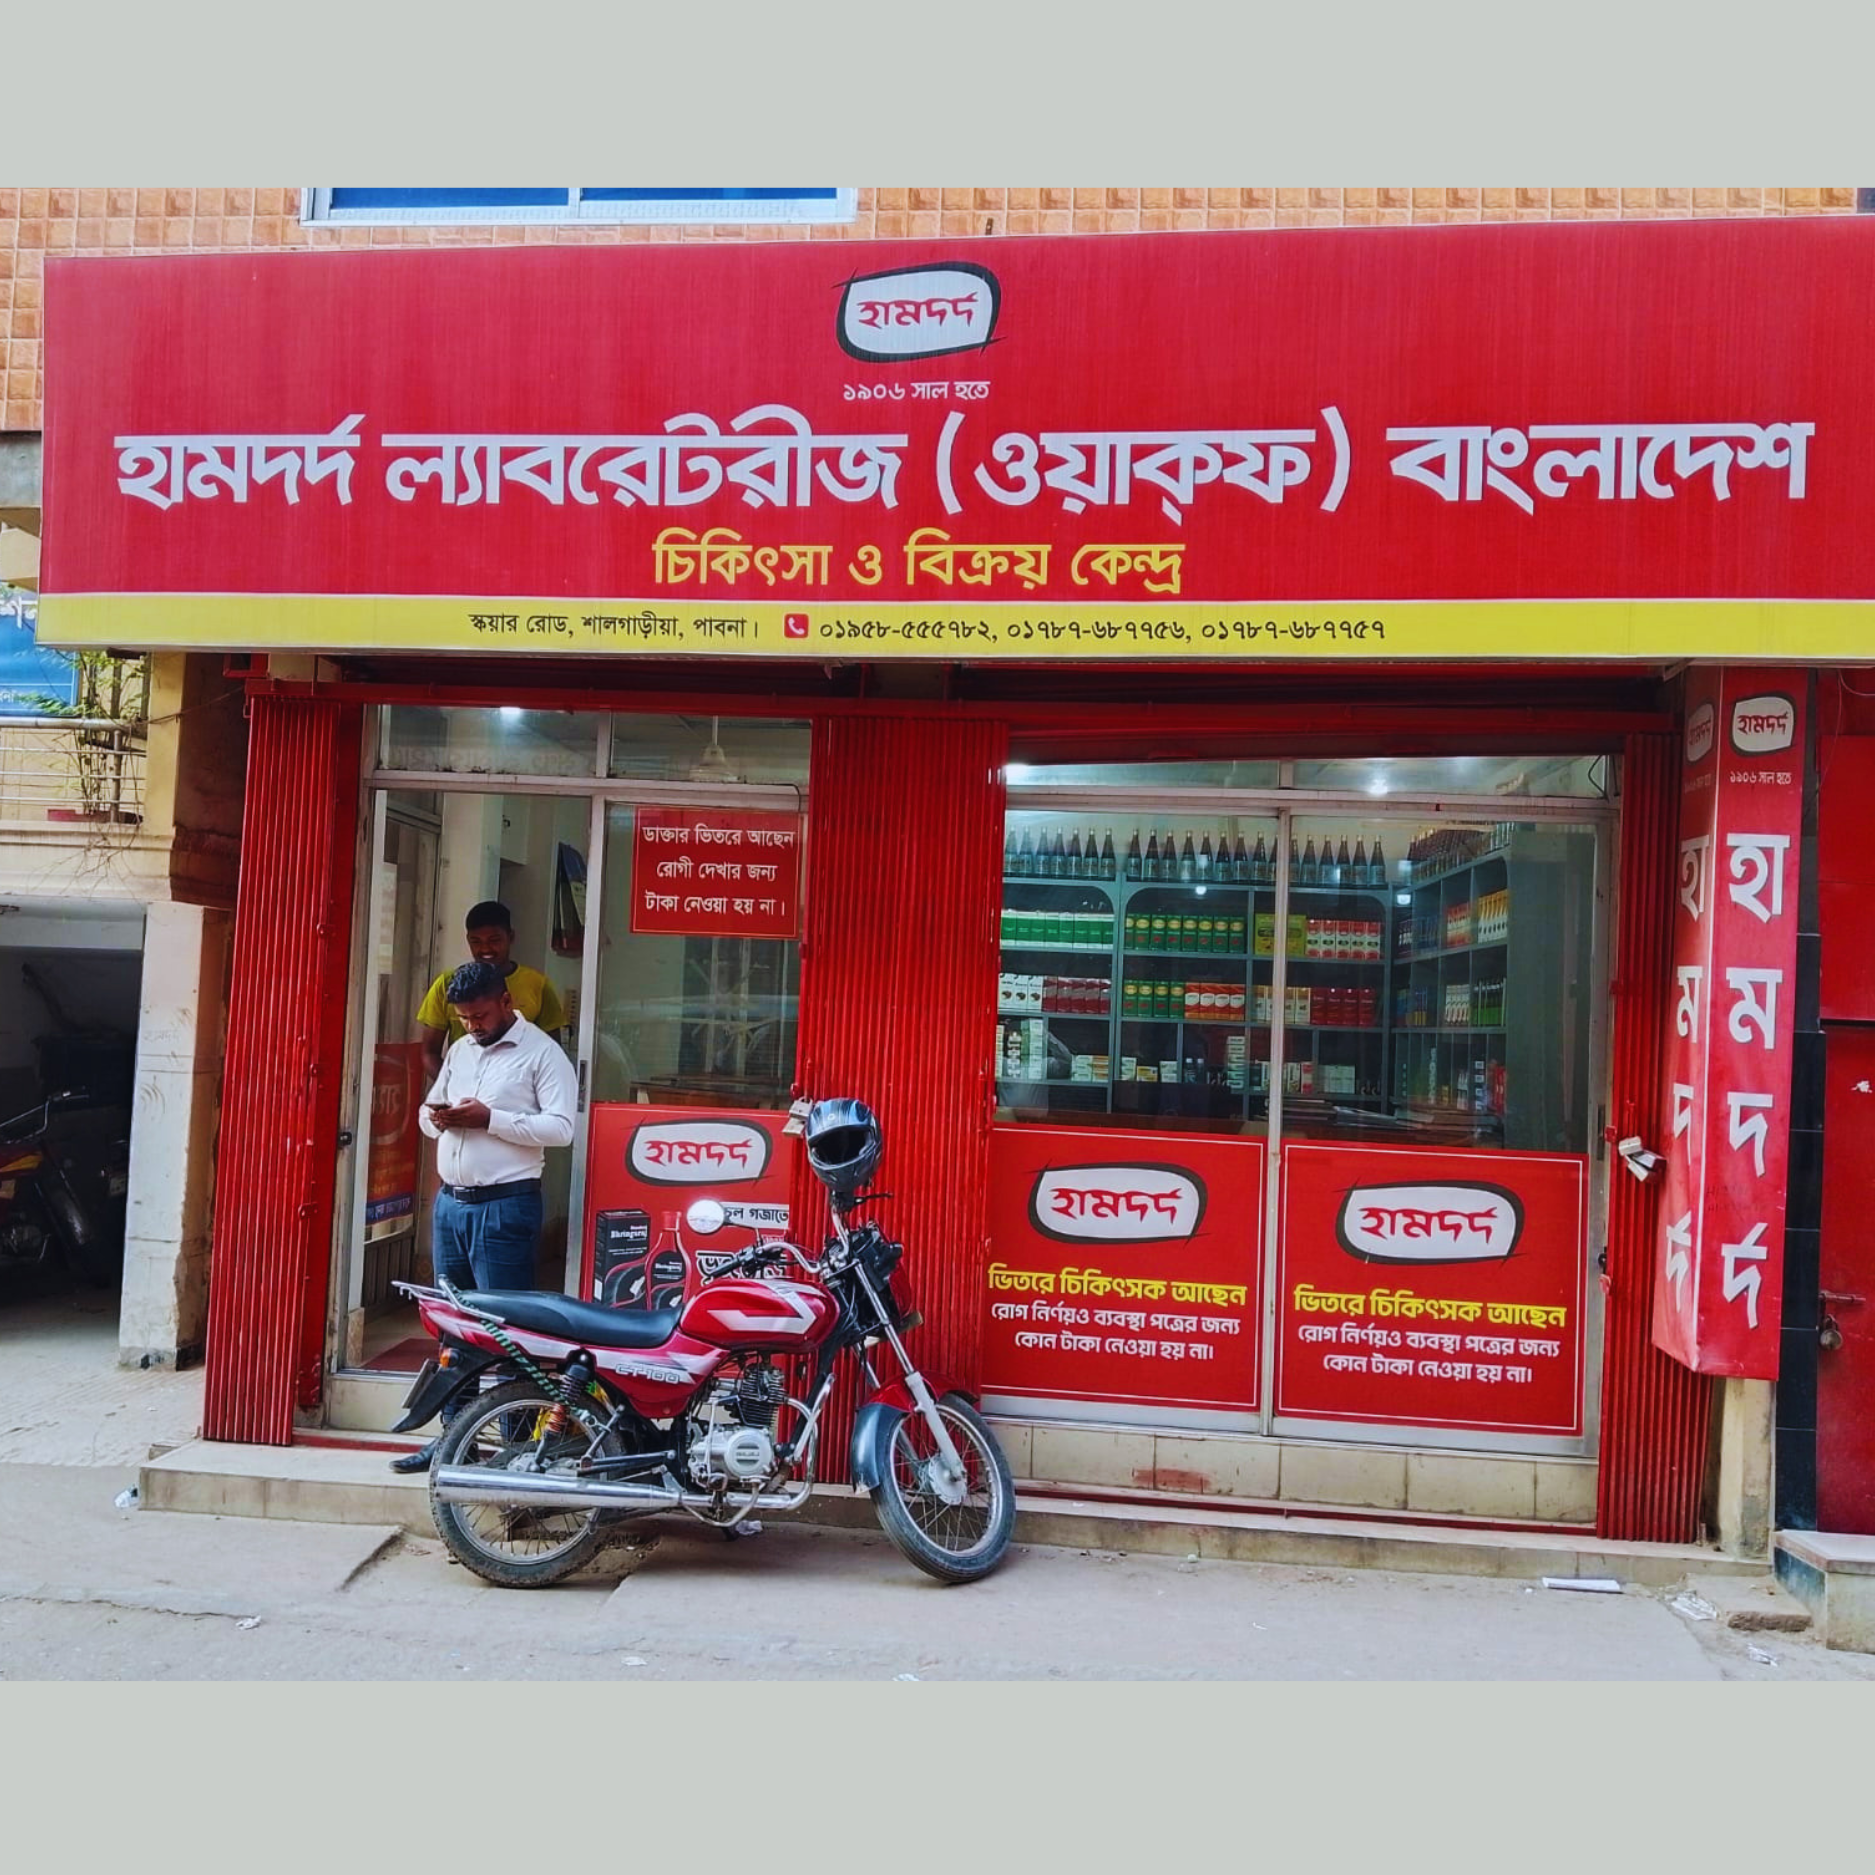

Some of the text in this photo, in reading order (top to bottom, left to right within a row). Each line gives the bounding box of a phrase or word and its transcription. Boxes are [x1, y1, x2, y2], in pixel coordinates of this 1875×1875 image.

[858, 292, 977, 328] হামদর্দ
[843, 381, 990, 400] ১৯০৬ সাল হতে
[114, 414, 365, 510] হামদর্দ
[381, 404, 908, 509] ল্যাবরেটরীজ
[1386, 423, 1815, 515] বাংলাদেশ
[652, 527, 1185, 594] চিকিৎসা ও বিক্রয় কেন্দ্র
[469, 614, 519, 633] স্কয়ার
[526, 615, 573, 638] রোড,
[581, 611, 683, 640] শালগাড়ীয়া,
[820, 620, 997, 643] ০১৯৫৮-৫৫৫৭৮২,
[1008, 620, 1191, 644] ০১৭৮৭-৬৮৭৭৫৬,
[1202, 620, 1385, 640] ০১৭৮৭-৬৮৭৭৫৭
[1738, 711, 1788, 735] হামদর্দ
[642, 823, 795, 849] ডাক্তার ভিতরে আছেন
[656, 856, 778, 882] রোগী দেখার জন্য
[645, 890, 679, 912] টাকা
[684, 897, 727, 915] নেওয়া
[733, 898, 754, 915] হয়
[645, 1139, 752, 1169] হামদর্দ
[1052, 1185, 1183, 1225] হামদর্দ
[1360, 1206, 1498, 1245] হামদর্দ
[988, 1263, 1247, 1306] ভিতরে চিকিৎসক আছেন
[991, 1303, 1028, 1320] রোগ
[1094, 1309, 1145, 1331] ব্যবস্থা
[1150, 1313, 1197, 1333] পত্রের
[1202, 1317, 1240, 1334] জন্য
[1293, 1284, 1567, 1329] ভিতরে চিকিৎসক আছেন
[1015, 1331, 1056, 1349] কোন
[1061, 1331, 1100, 1353] টাকা
[1105, 1338, 1156, 1357] নেওয়া
[1160, 1342, 1185, 1360] হয়
[1298, 1324, 1337, 1343] রোগ
[1406, 1331, 1460, 1354] ব্যবস্থা
[1465, 1335, 1515, 1356] পত্রের
[1519, 1338, 1560, 1357] জন্য
[1324, 1354, 1366, 1373] কোন
[1371, 1353, 1413, 1376] টাকা
[1418, 1361, 1471, 1381] নেওয়া
[1475, 1365, 1502, 1384] হয়
